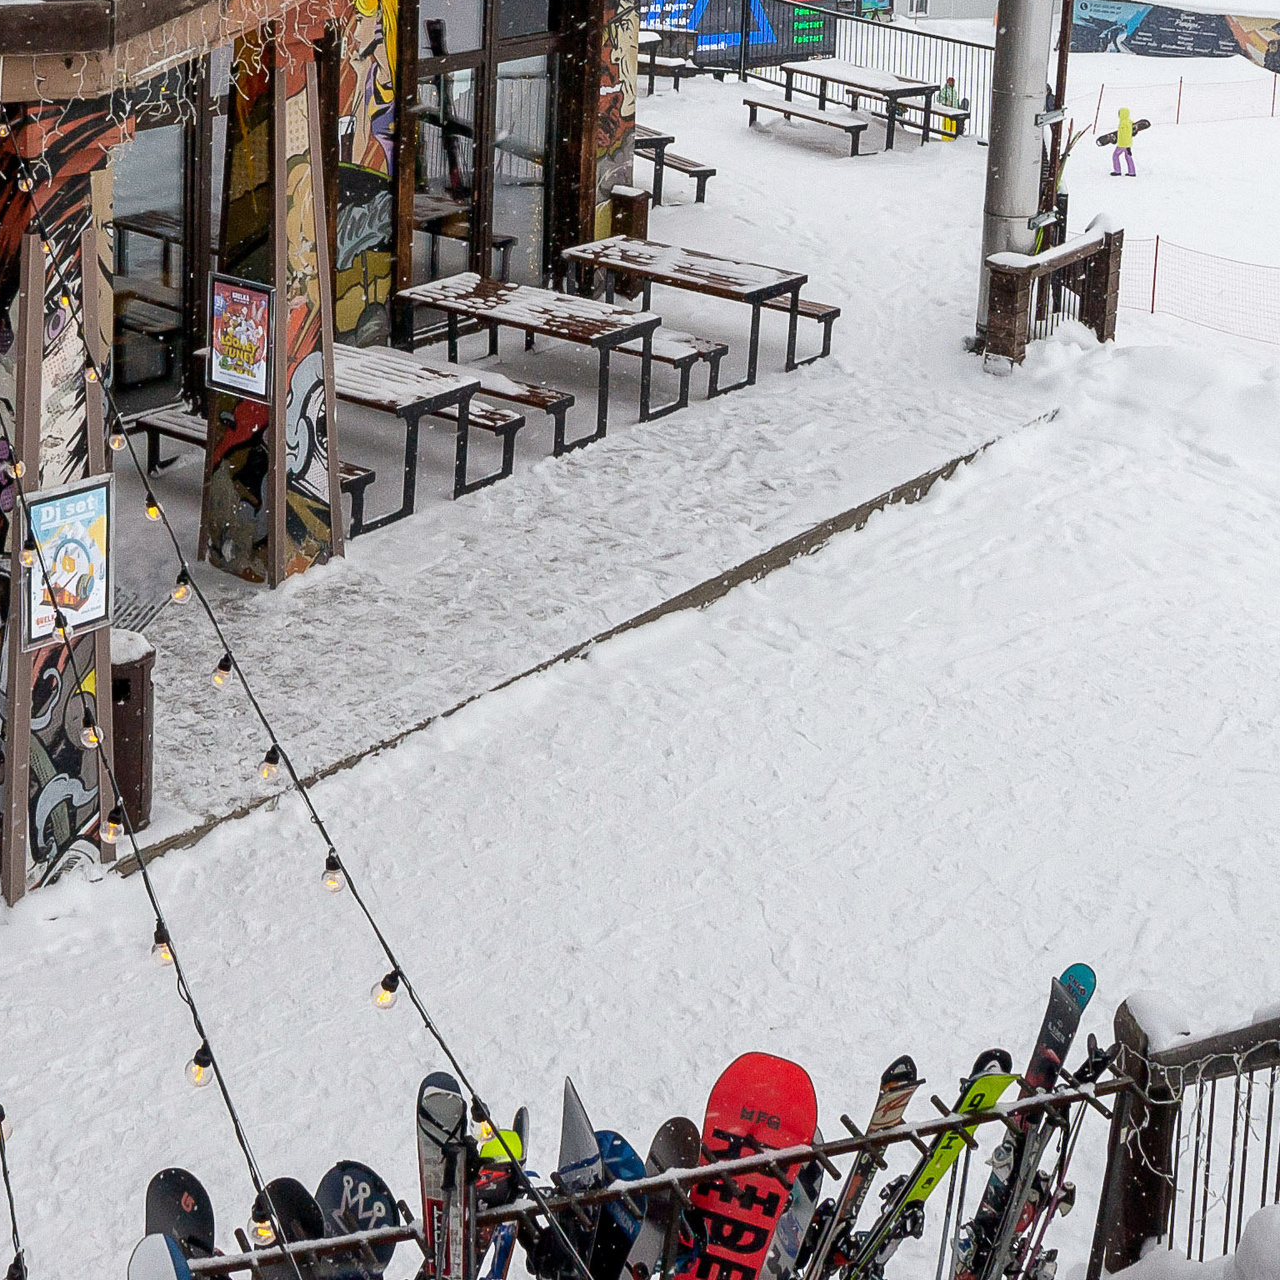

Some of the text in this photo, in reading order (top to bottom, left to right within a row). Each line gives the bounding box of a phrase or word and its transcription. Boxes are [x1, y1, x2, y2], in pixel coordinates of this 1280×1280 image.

[220, 335, 260, 355] LOONEY
[65, 494, 96, 517] set
[739, 1106, 782, 1131] MFG
